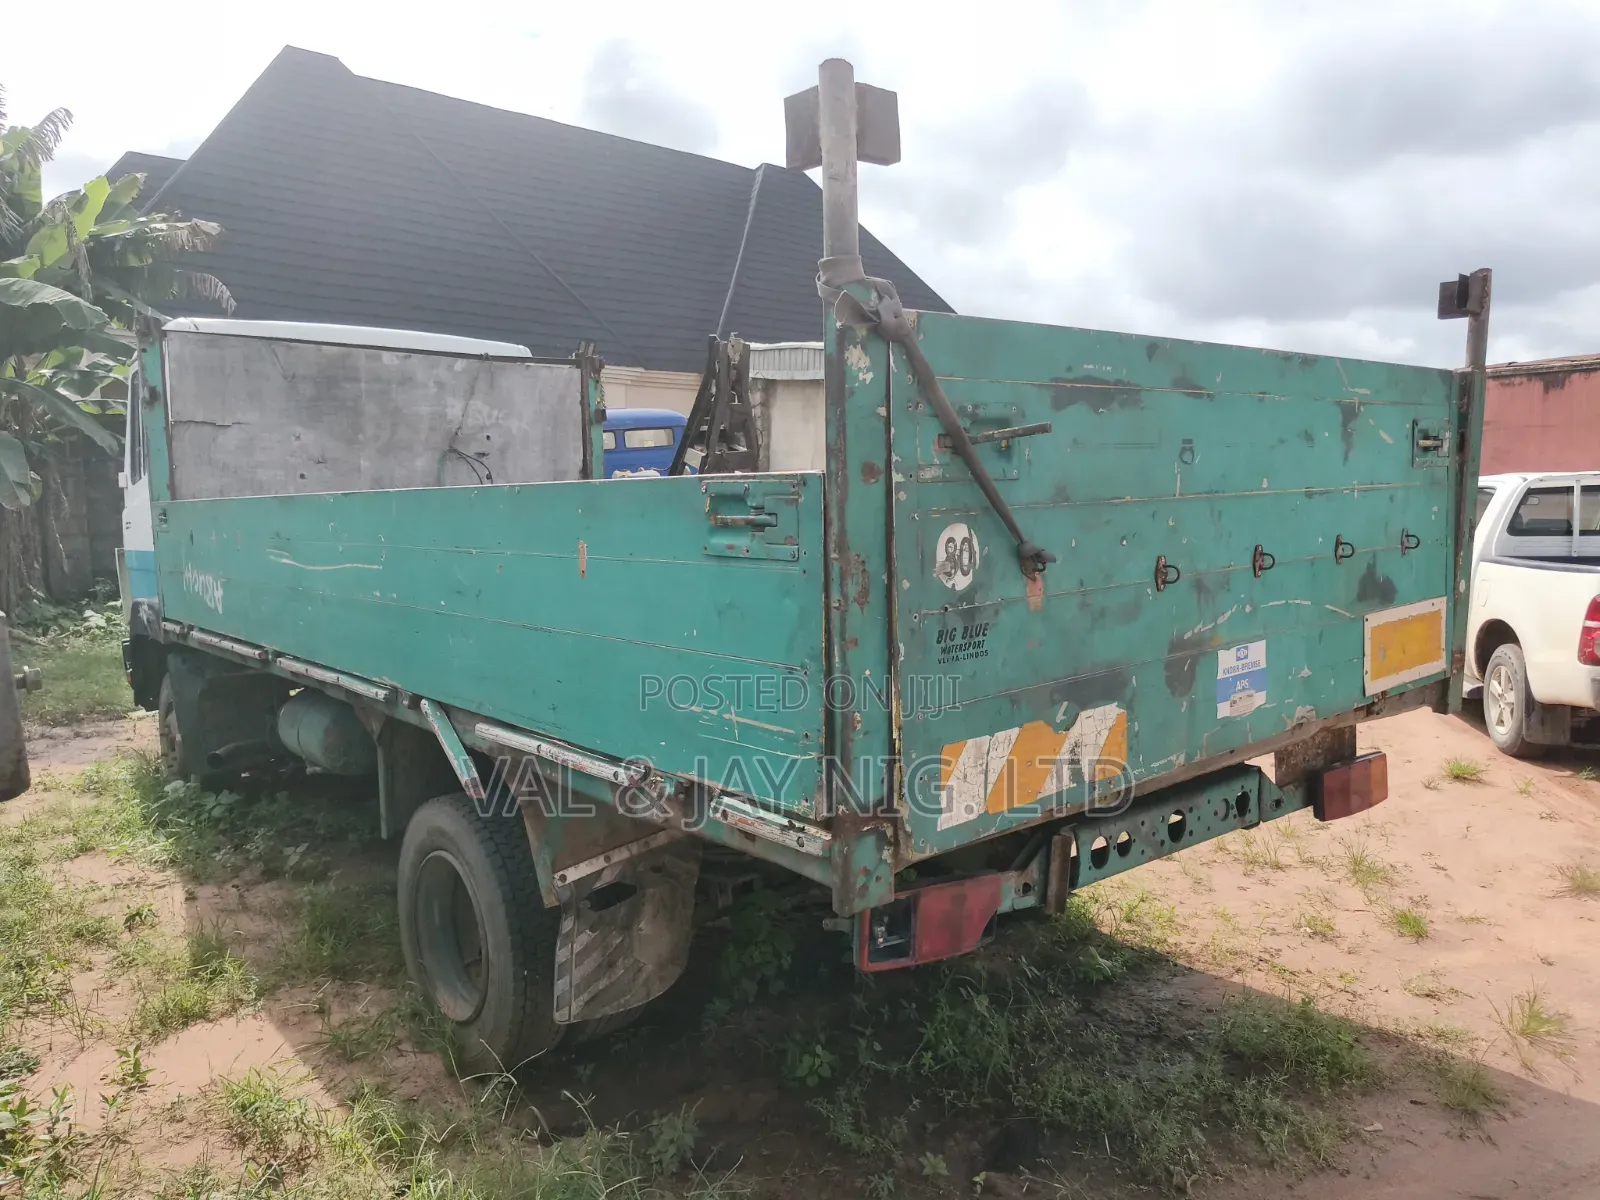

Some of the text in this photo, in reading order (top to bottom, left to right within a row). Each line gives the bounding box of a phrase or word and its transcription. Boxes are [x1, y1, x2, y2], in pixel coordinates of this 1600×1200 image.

[936, 622, 989, 645] BIG BLUE
[940, 639, 985, 656] WATERSPORT
